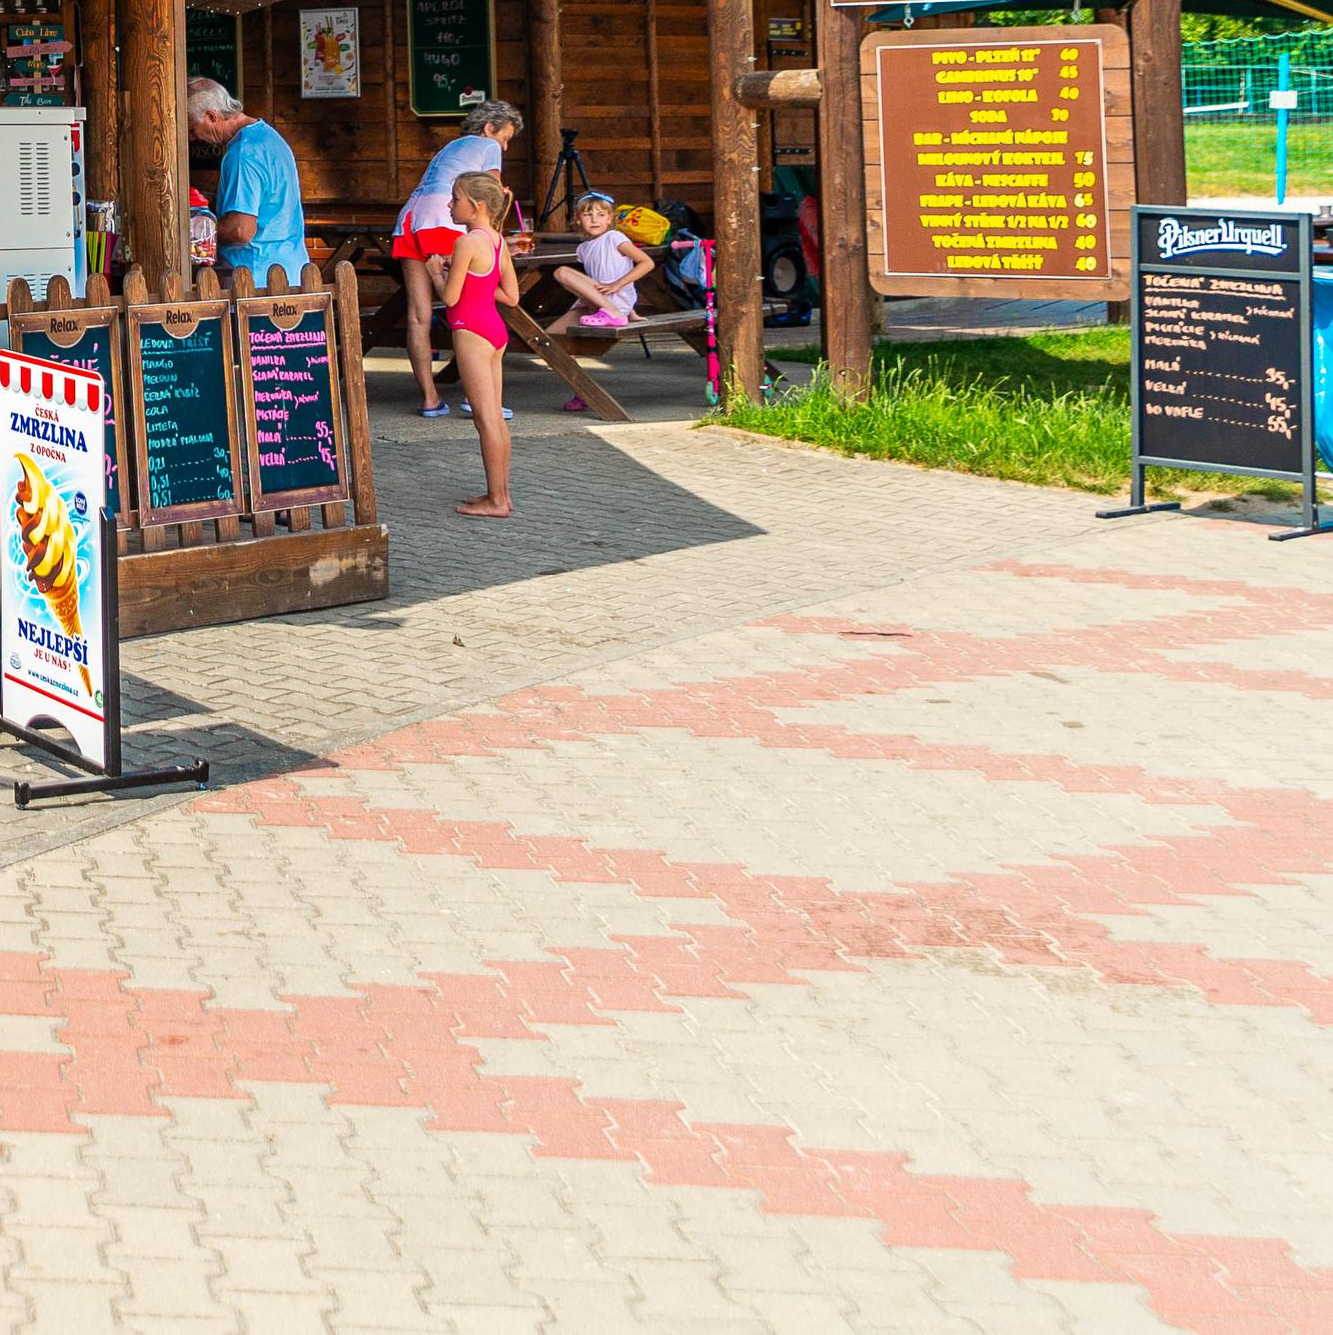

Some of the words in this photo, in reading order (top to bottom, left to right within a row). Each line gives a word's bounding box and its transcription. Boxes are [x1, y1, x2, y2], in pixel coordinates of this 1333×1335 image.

[969, 110, 1008, 123] SODA
[1073, 172, 1096, 189] 50
[165, 310, 193, 325] Relax
[272, 303, 298, 318] Relax
[50, 317, 79, 333] Relax
[142, 358, 174, 371] MANGO
[34, 403, 59, 423] ČESKÁ
[145, 405, 169, 416] COLA
[10, 412, 88, 453] ZMRZLINA
[30, 442, 35, 453] Z
[36, 445, 67, 463] OPOČNA
[17, 617, 88, 665] NEJLEPŠÍ
[34, 648, 44, 660] JE
[44, 652, 50, 663] U
[52, 654, 68, 670] NÁS
